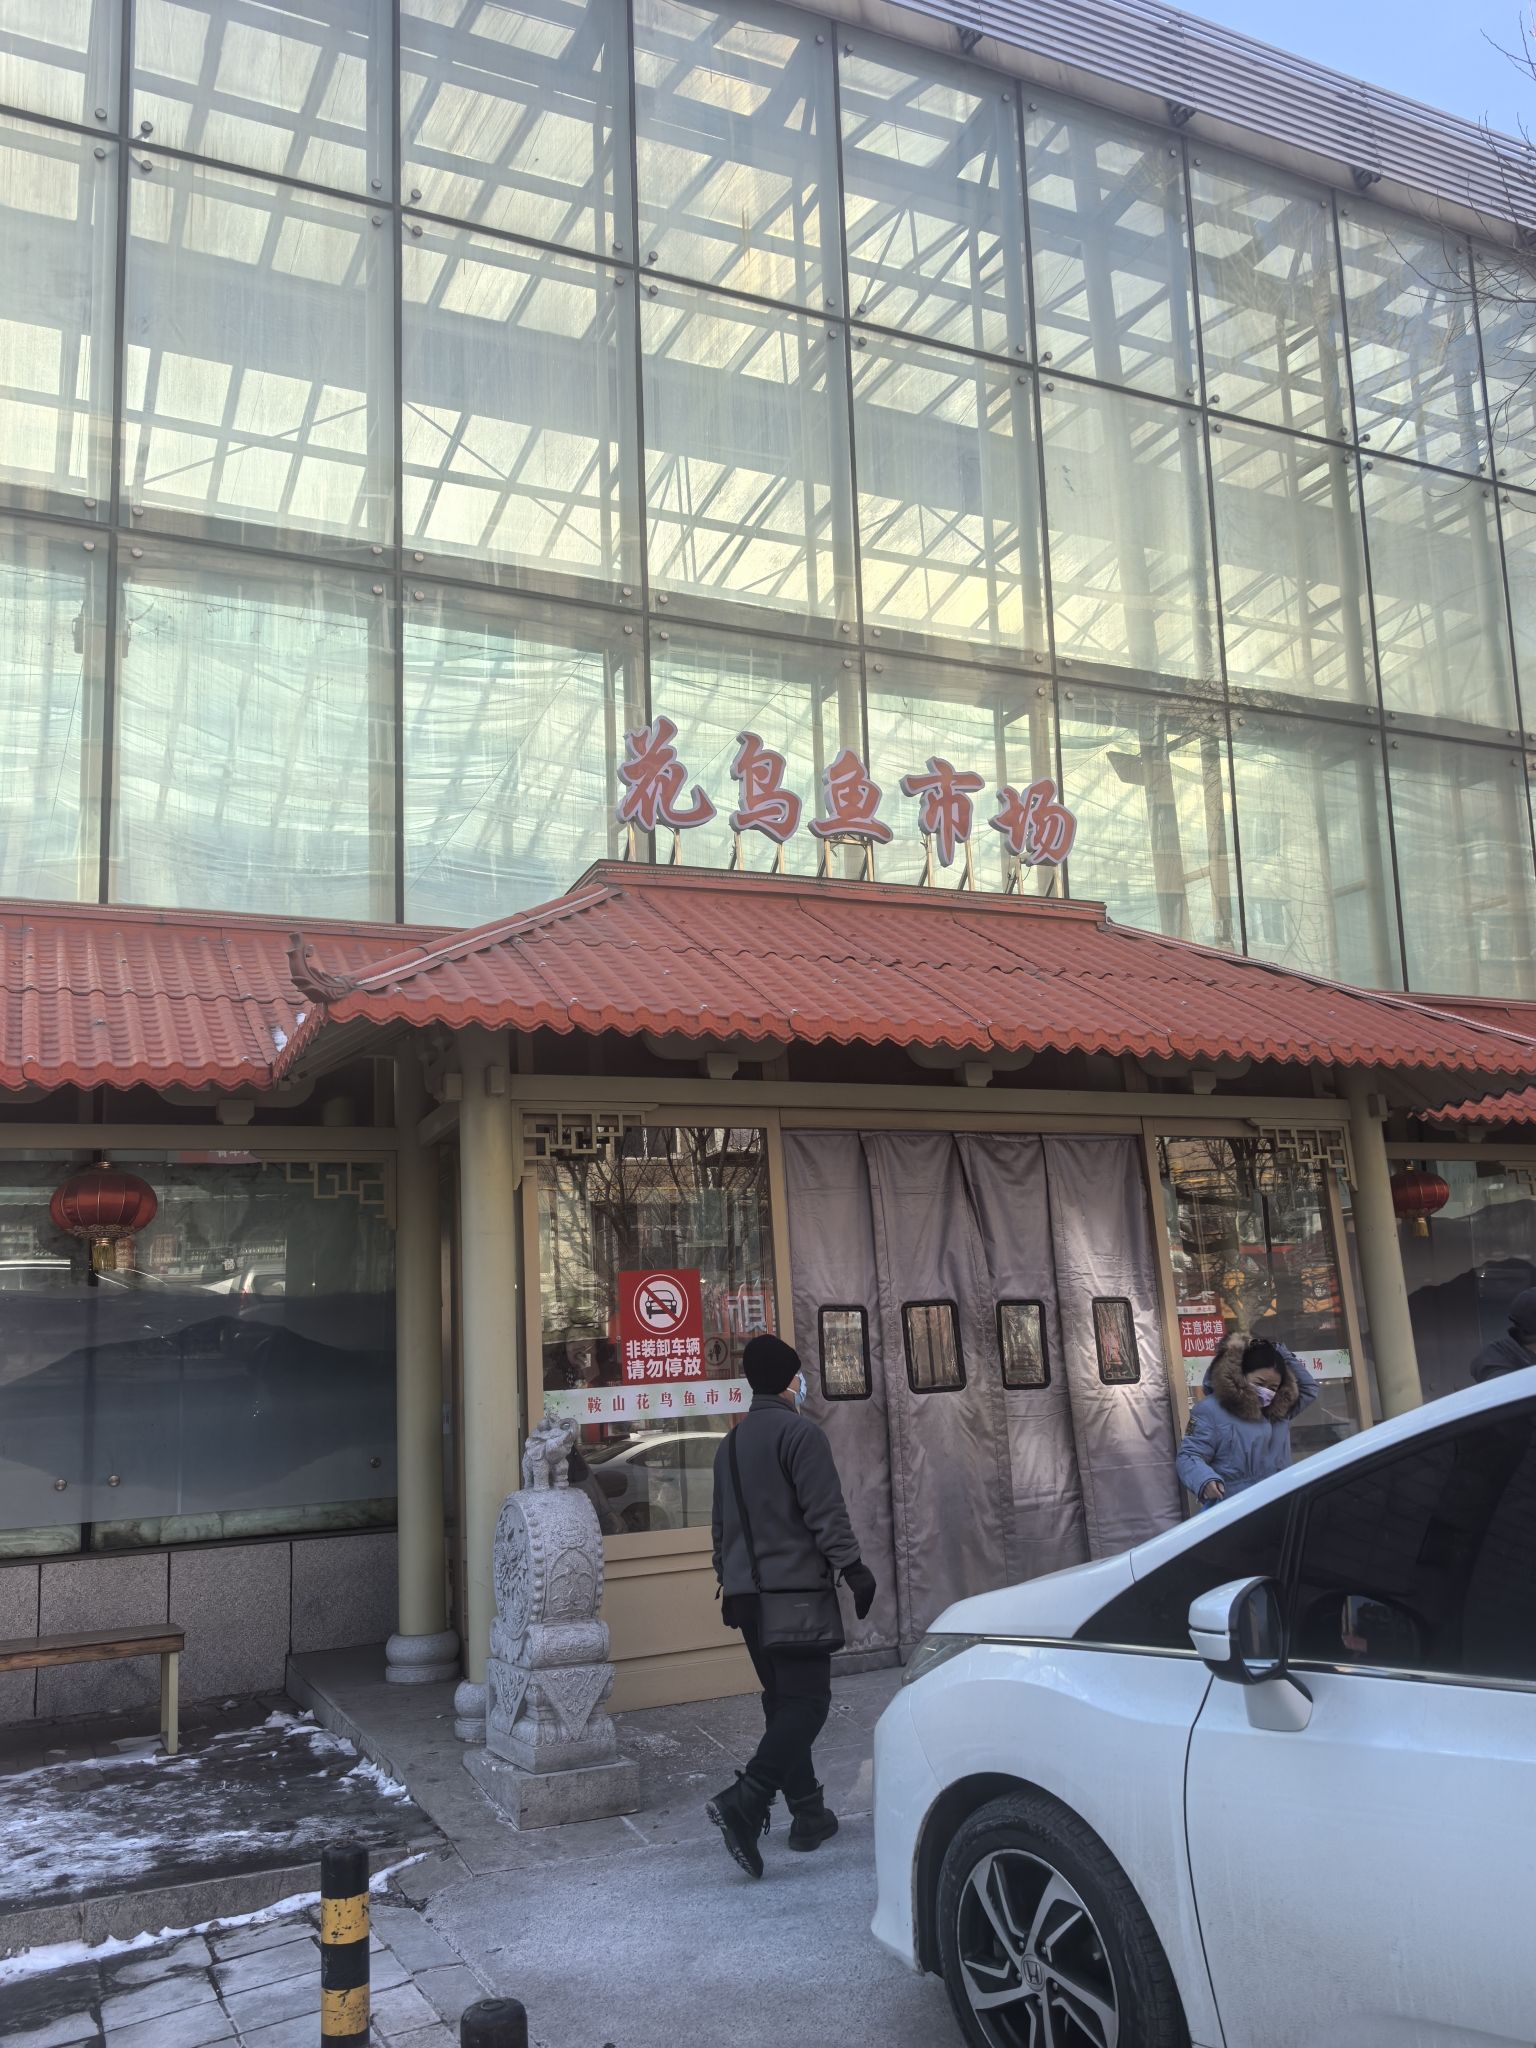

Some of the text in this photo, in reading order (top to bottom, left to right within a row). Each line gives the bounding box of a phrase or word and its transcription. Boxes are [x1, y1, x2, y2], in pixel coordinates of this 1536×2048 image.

[617, 715, 1077, 867] 花鸟鱼市场
[1182, 1320, 1223, 1336] 注意坡道
[626, 1337, 700, 1359] 非装卸车辆
[627, 1357, 702, 1380] 请勿停放
[587, 1387, 743, 1414] 鞍山花鸟鱼市场
